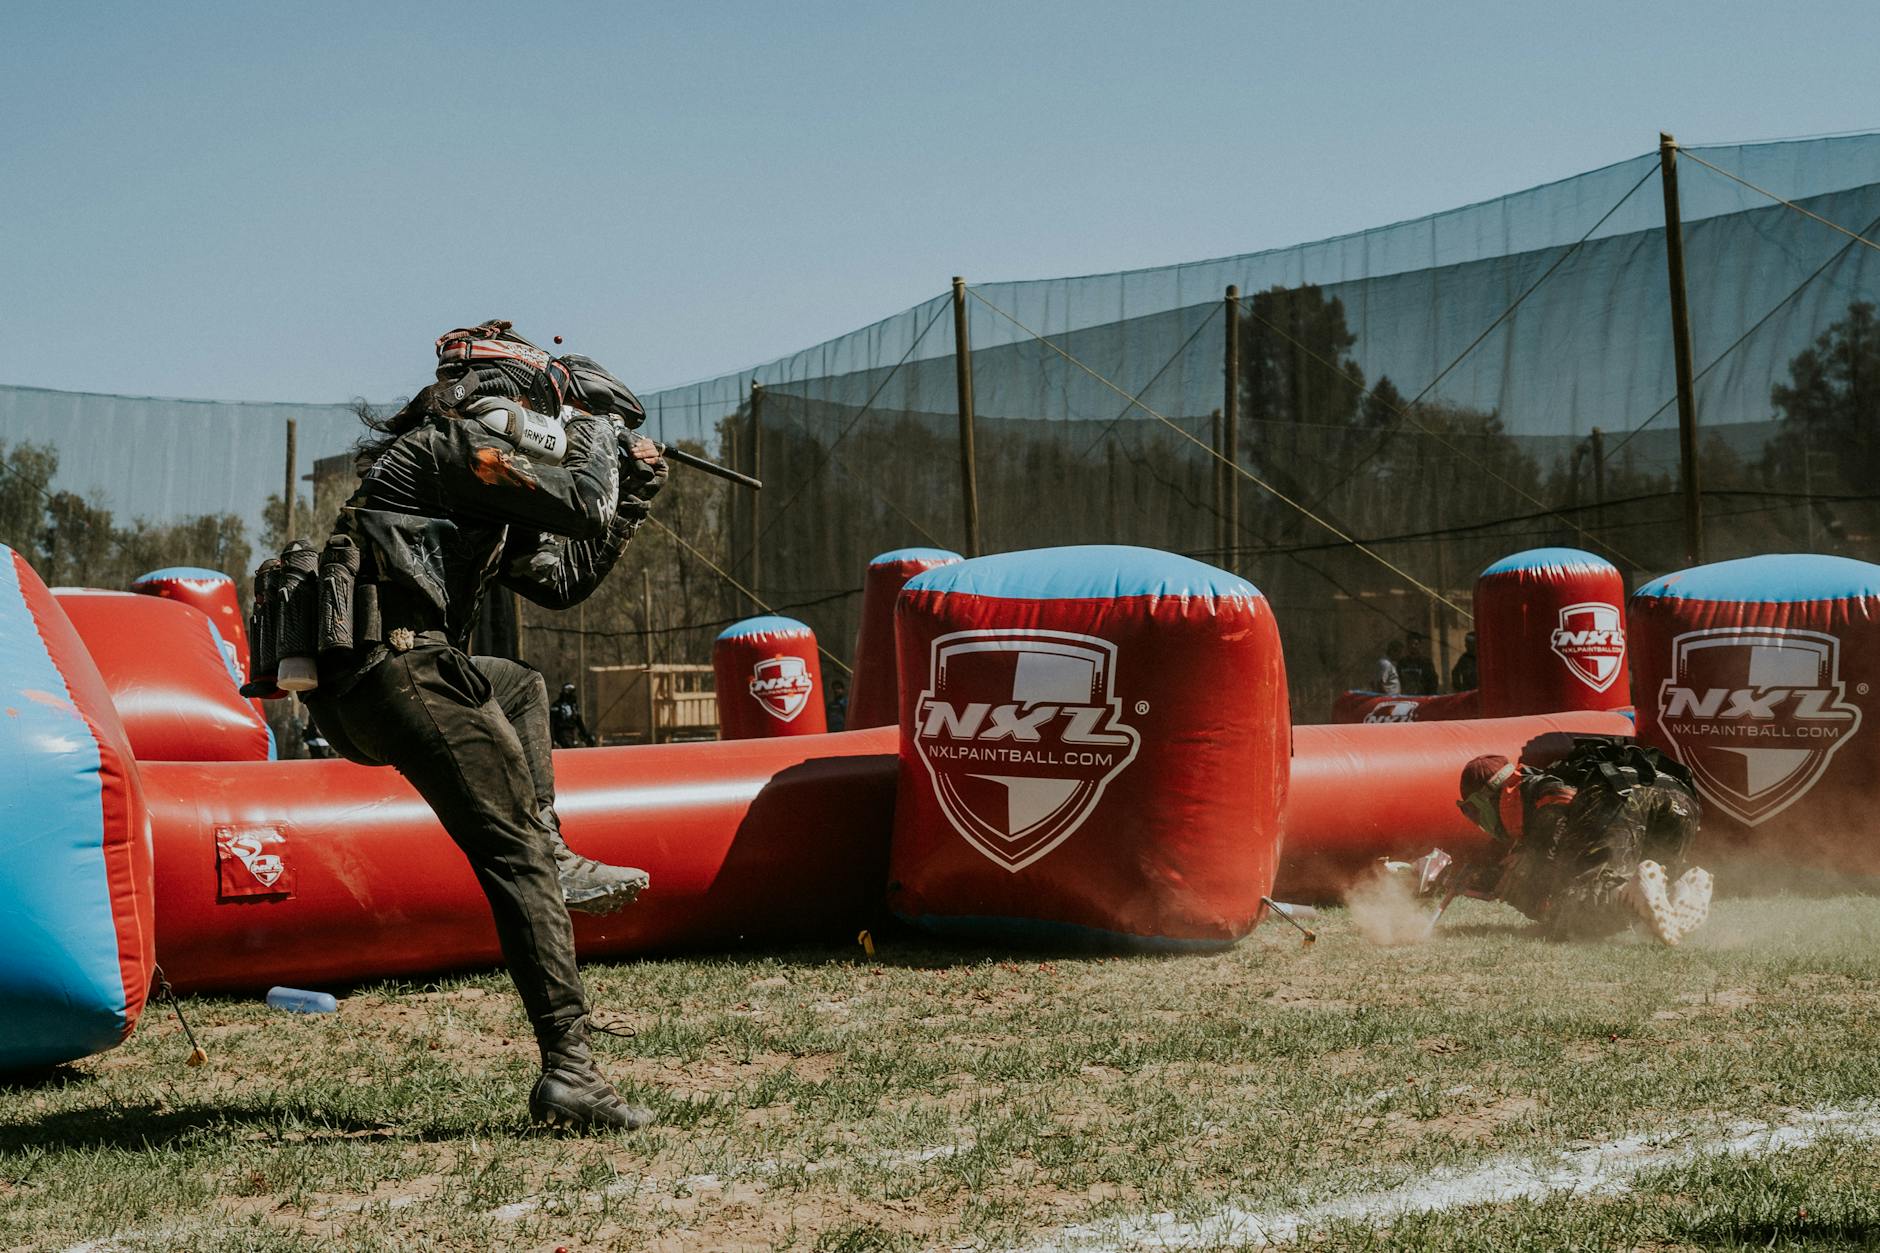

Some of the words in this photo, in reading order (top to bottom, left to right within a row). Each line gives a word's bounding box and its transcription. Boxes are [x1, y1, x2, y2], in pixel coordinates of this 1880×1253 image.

[1557, 630, 1624, 646] NXL
[754, 675, 809, 692] NXL
[1665, 687, 1853, 720] NXL
[921, 700, 1130, 746] NXL
[1672, 723, 1840, 738] NXLPAINTBALL.COM
[929, 745, 1113, 767] NXLPAINTBALL.COM
